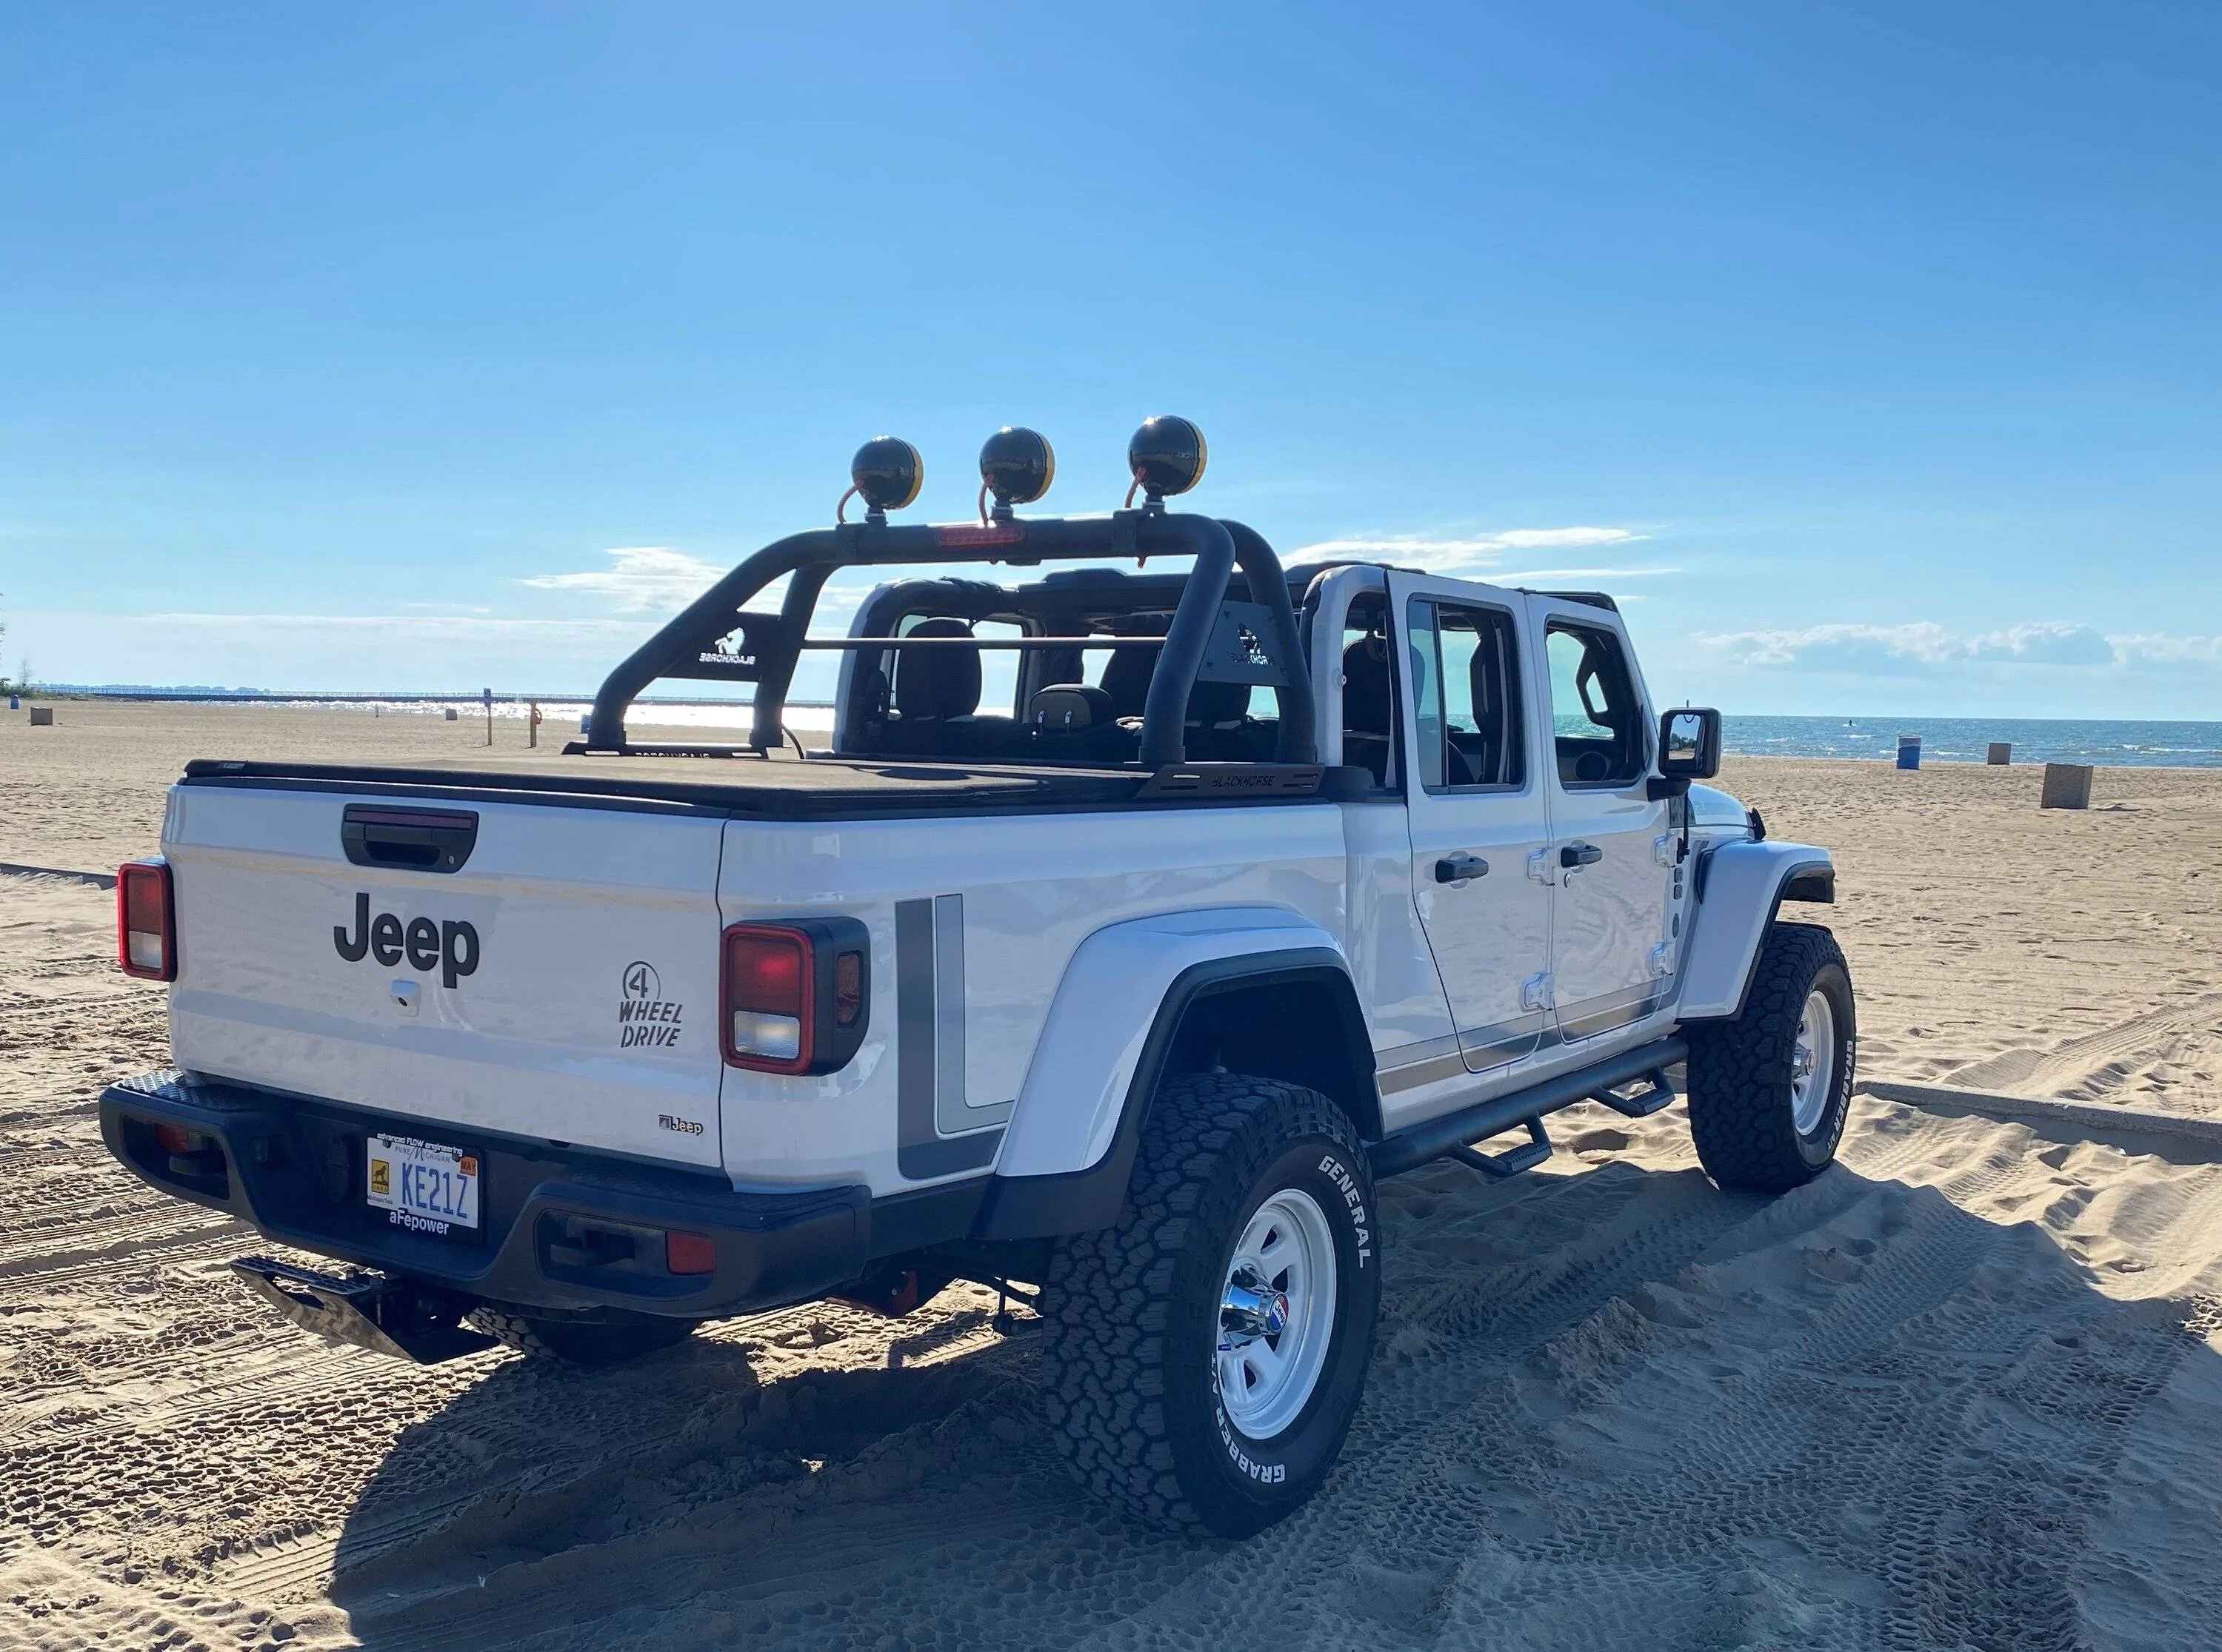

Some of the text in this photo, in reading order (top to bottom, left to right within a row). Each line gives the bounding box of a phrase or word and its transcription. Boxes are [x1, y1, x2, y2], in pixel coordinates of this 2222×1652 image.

[1212, 775, 1275, 789] BLACKHORSE
[333, 892, 479, 989] Jeep
[629, 968, 648, 998] 4
[619, 1000, 683, 1024] WHEEL
[621, 1026, 681, 1048] DRIVE
[1834, 1040, 1853, 1132] GRABBER
[672, 1117, 703, 1135] Jeep
[377, 1133, 463, 1157] advanced FLOW engineering
[395, 1146, 410, 1155] PURE
[461, 1160, 476, 1172] MAY
[402, 1163, 467, 1219] KE21Z
[390, 1209, 450, 1235] aFepower
[1318, 1155, 1370, 1268] GENERAL
[1215, 1403, 1286, 1483] GRABBER
